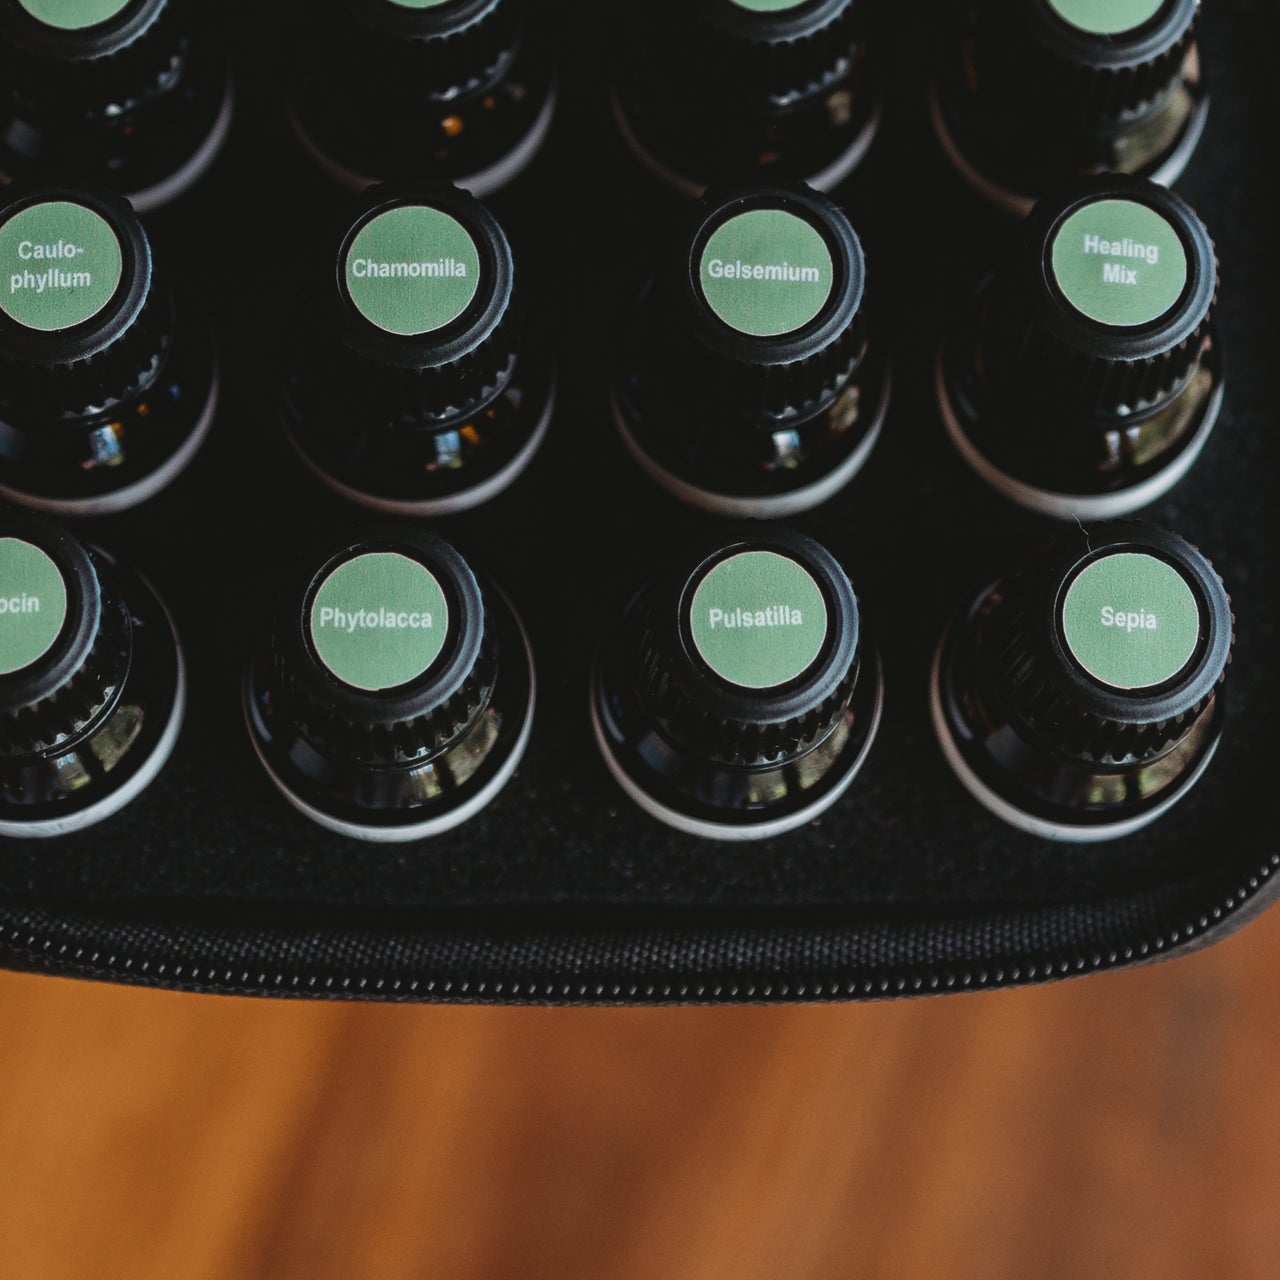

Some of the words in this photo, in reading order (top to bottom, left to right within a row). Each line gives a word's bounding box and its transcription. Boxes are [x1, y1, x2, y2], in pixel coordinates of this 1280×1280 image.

[17, 239, 85, 261] Caulo-
[1083, 234, 1160, 265] Healing
[352, 257, 467, 279] Chamomilla
[707, 259, 820, 282] Gelsemium
[1102, 263, 1139, 286] Mix
[10, 268, 92, 294] phyllum
[319, 606, 434, 633] Phytolacca
[709, 605, 803, 629] Pulsatilla
[1100, 605, 1159, 632] Sepia
